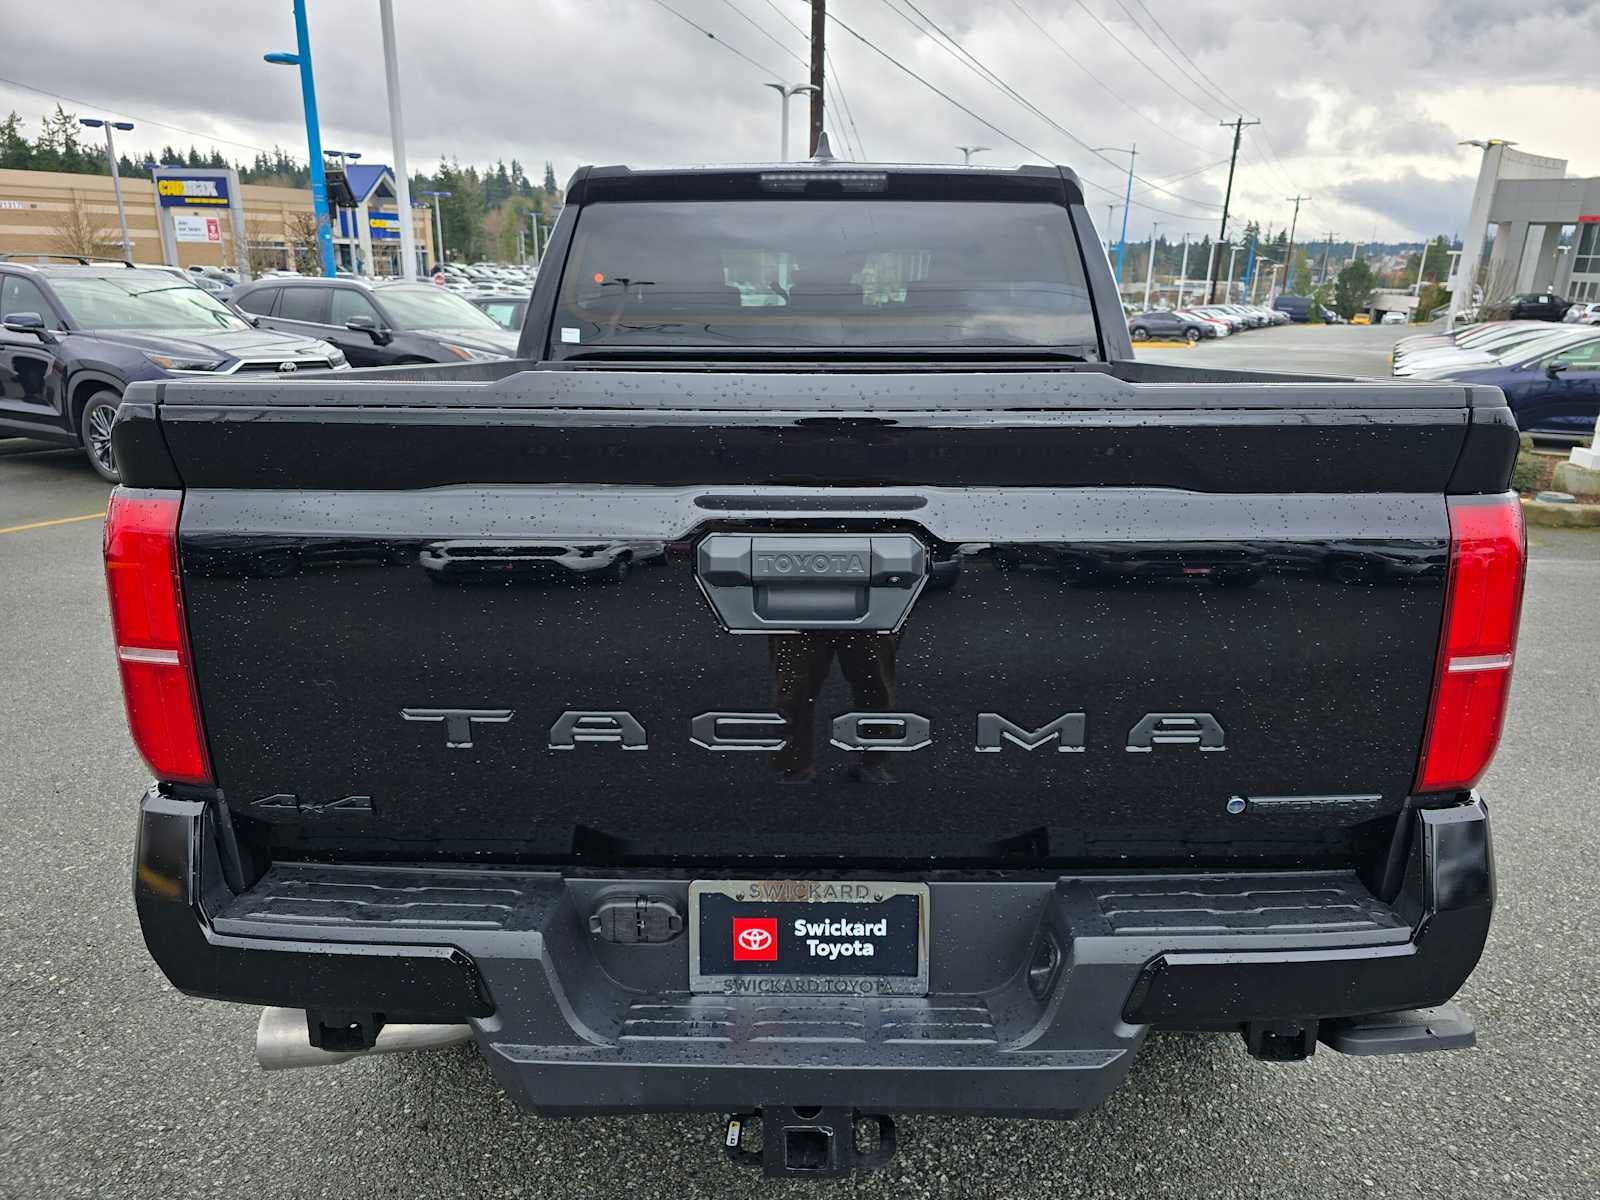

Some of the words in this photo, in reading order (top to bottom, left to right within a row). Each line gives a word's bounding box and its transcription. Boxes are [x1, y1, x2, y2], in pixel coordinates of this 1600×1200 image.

[758, 553, 865, 574] TOYOTA
[399, 708, 1227, 755] TACOMA
[748, 883, 871, 900] SWICKARD
[794, 918, 888, 937] Swickard
[806, 939, 875, 961] Toyota
